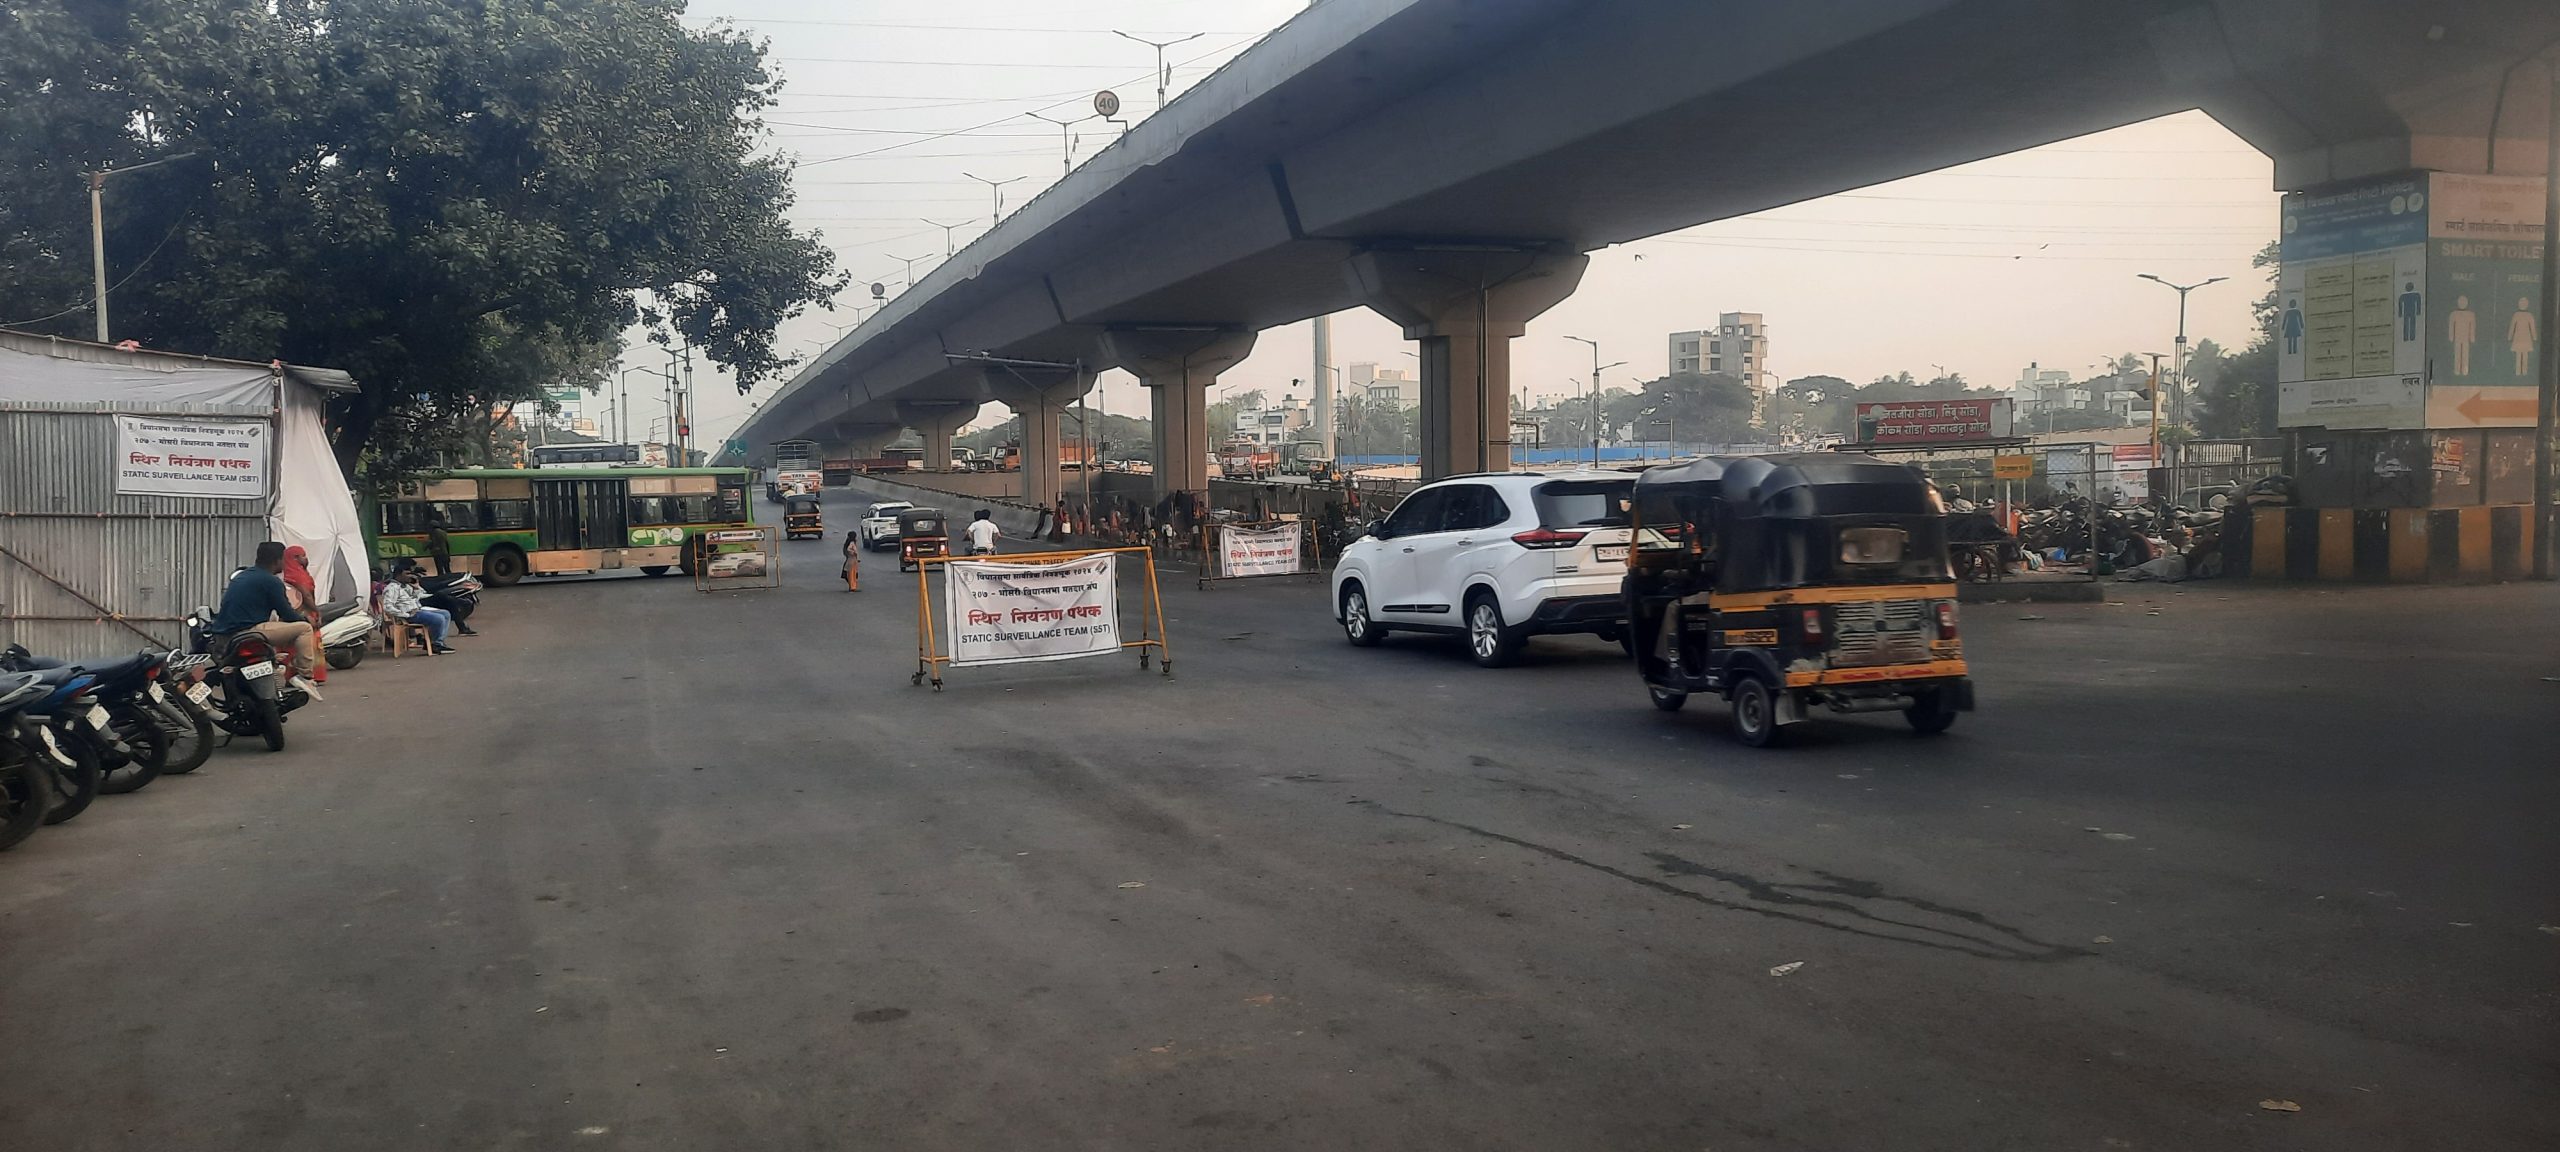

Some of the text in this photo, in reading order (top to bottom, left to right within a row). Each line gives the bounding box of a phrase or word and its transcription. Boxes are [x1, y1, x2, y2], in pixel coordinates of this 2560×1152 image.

[1099, 97, 1114, 109] 40
[2442, 243, 2544, 259] SMART TOILE
[130, 451, 251, 470] स्थिर नियंत्रण पथक
[123, 470, 259, 484] STATIC SURVEILLANCE TEAM (SST)
[1073, 567, 1092, 576] २०२४
[972, 590, 988, 599] २०७
[968, 605, 1102, 626] स्थिर नियंत्रण पथक
[961, 624, 1111, 644] STATIC SURVEILLANCE TEAM (SST)
